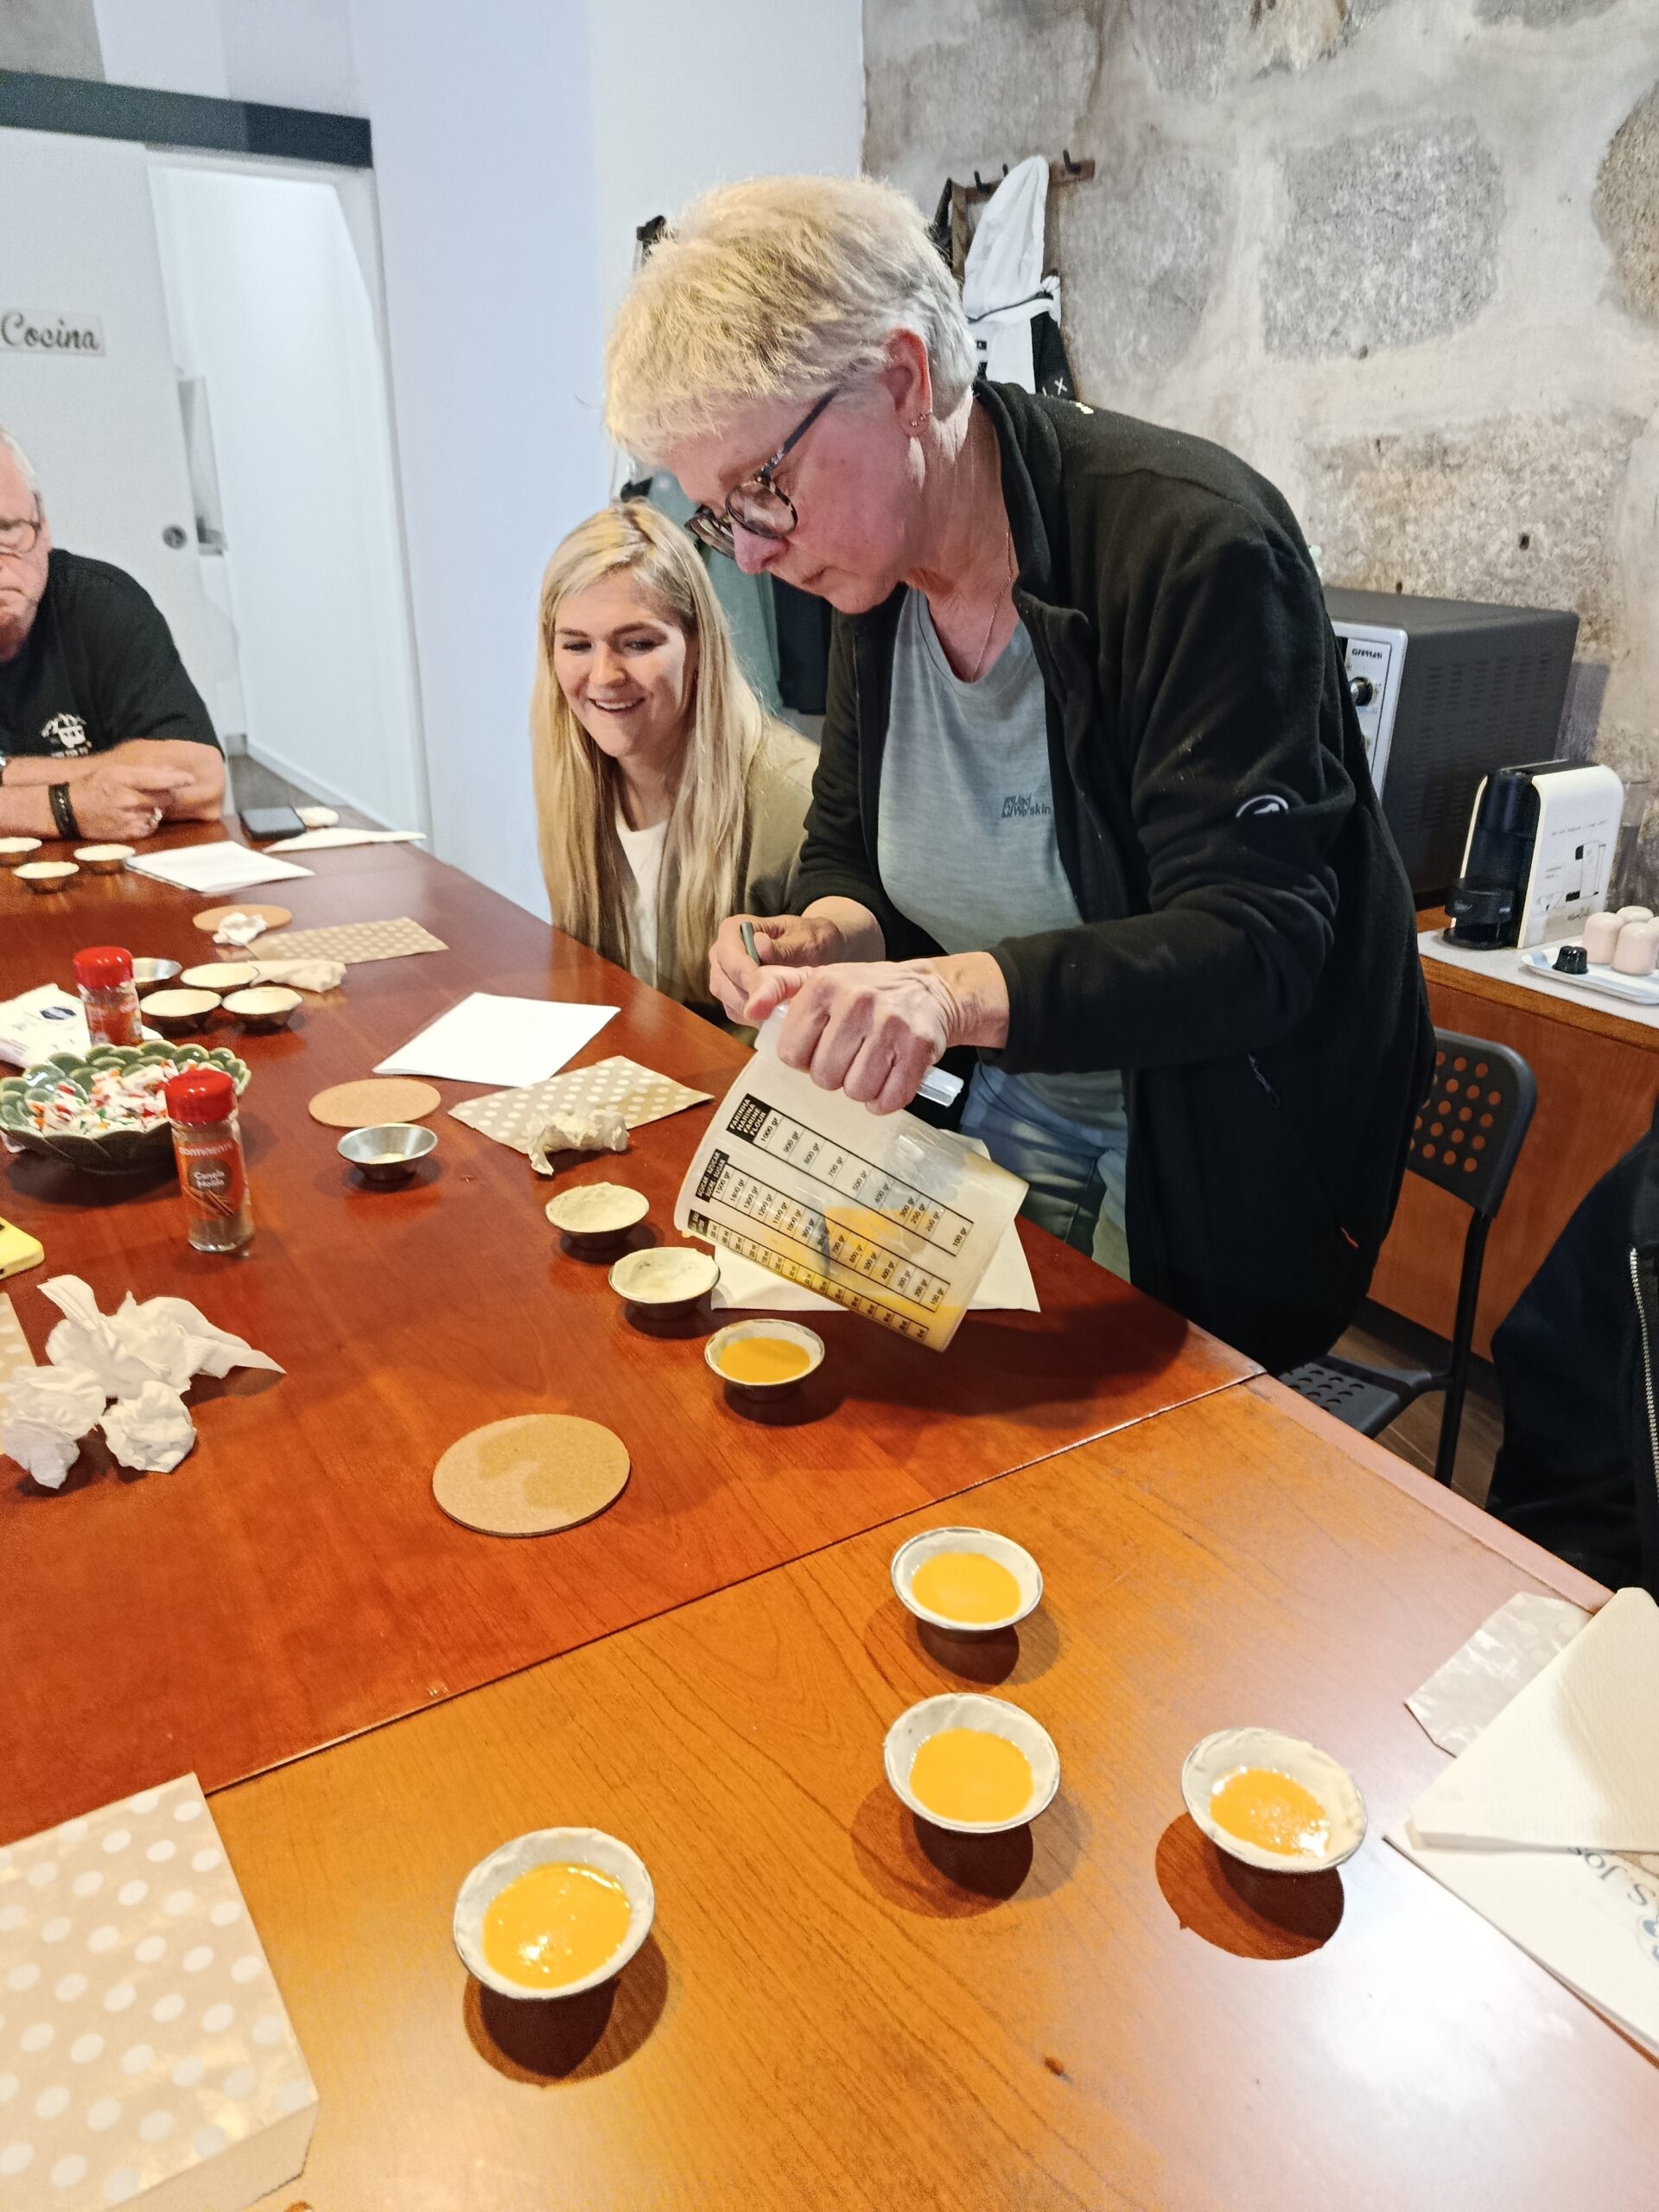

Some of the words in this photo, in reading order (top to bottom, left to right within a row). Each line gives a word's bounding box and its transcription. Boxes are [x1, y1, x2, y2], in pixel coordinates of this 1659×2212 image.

[1, 312, 99, 350] Cocina
[730, 1098, 750, 1129] FARINHA
[738, 1103, 755, 1131] HARINA
[743, 1108, 761, 1134] FARINE
[750, 1112, 766, 1136] FLOUR
